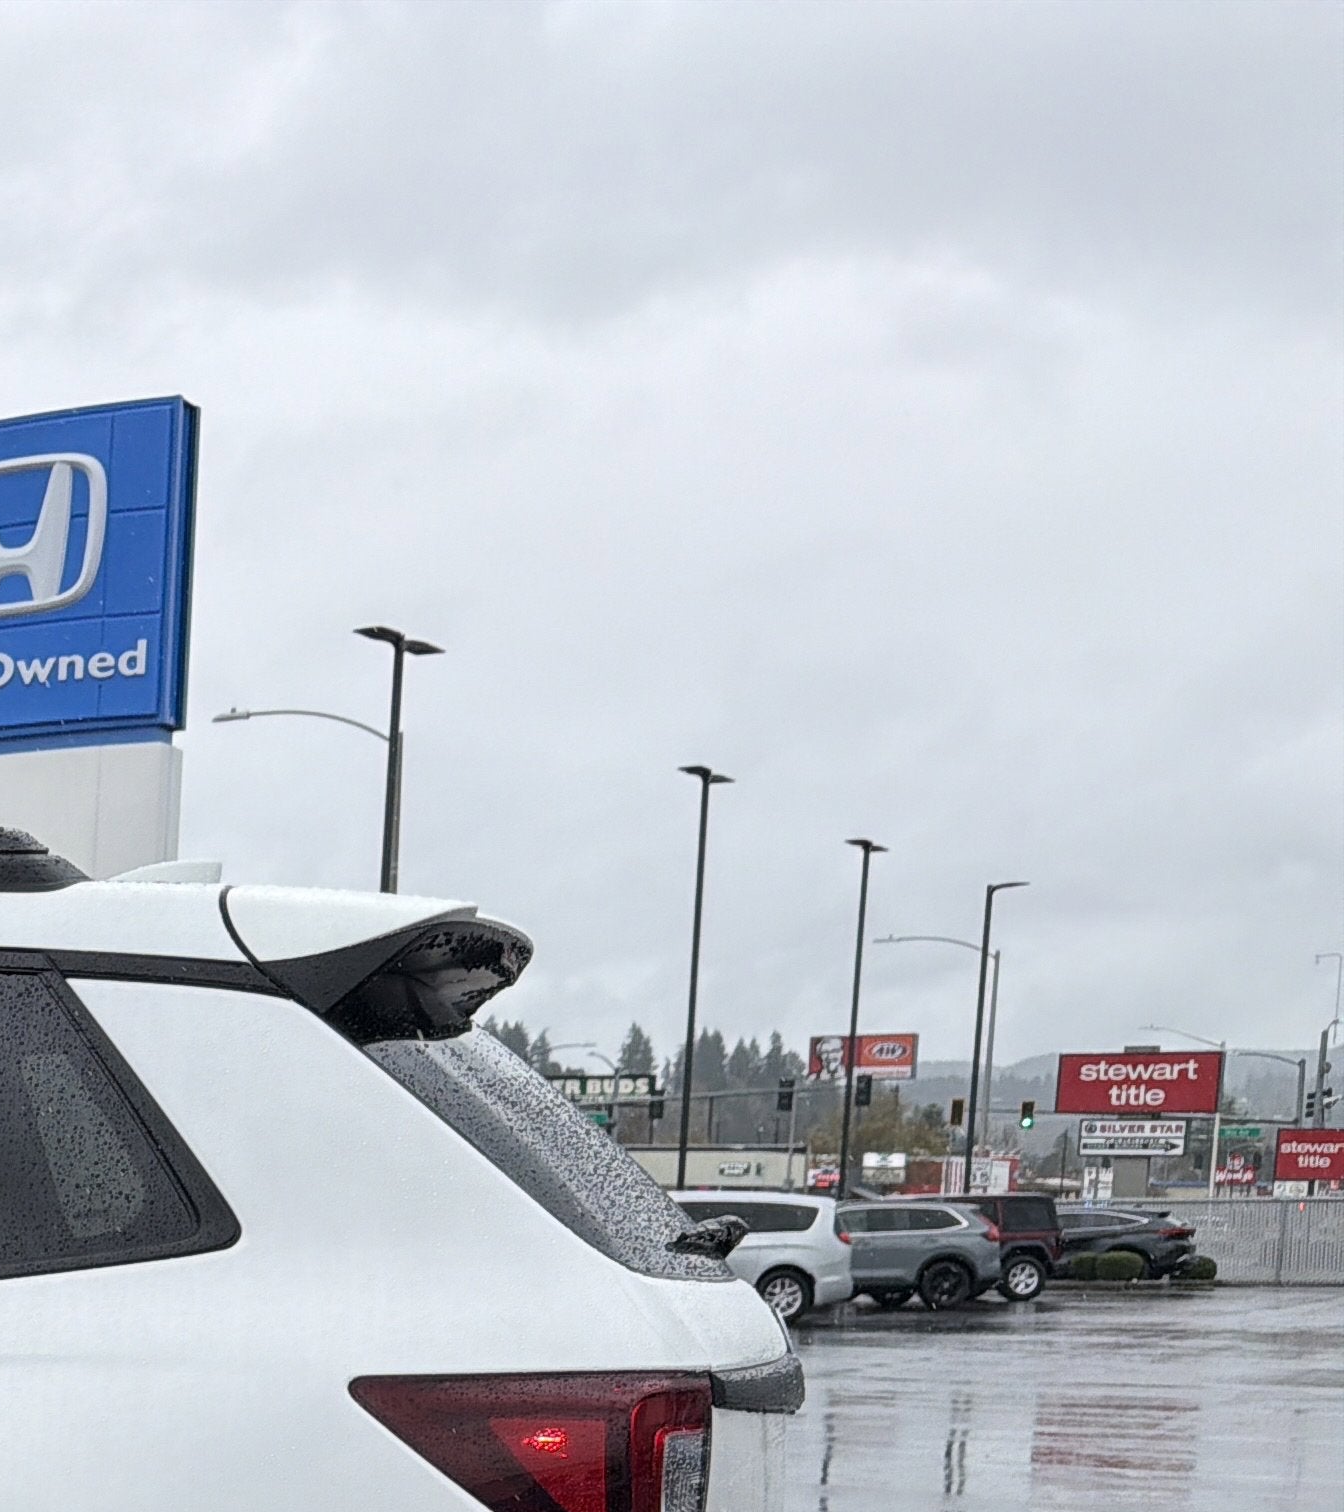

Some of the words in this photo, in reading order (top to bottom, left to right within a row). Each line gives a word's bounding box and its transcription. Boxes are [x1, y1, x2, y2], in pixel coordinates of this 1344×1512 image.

[1080, 1059, 1198, 1081] stewart
[586, 1077, 650, 1095] BUDS
[1108, 1083, 1166, 1106] title
[1099, 1124, 1145, 1134] SILVER
[1149, 1124, 1184, 1134] STAR
[1297, 1155, 1332, 1168] title
